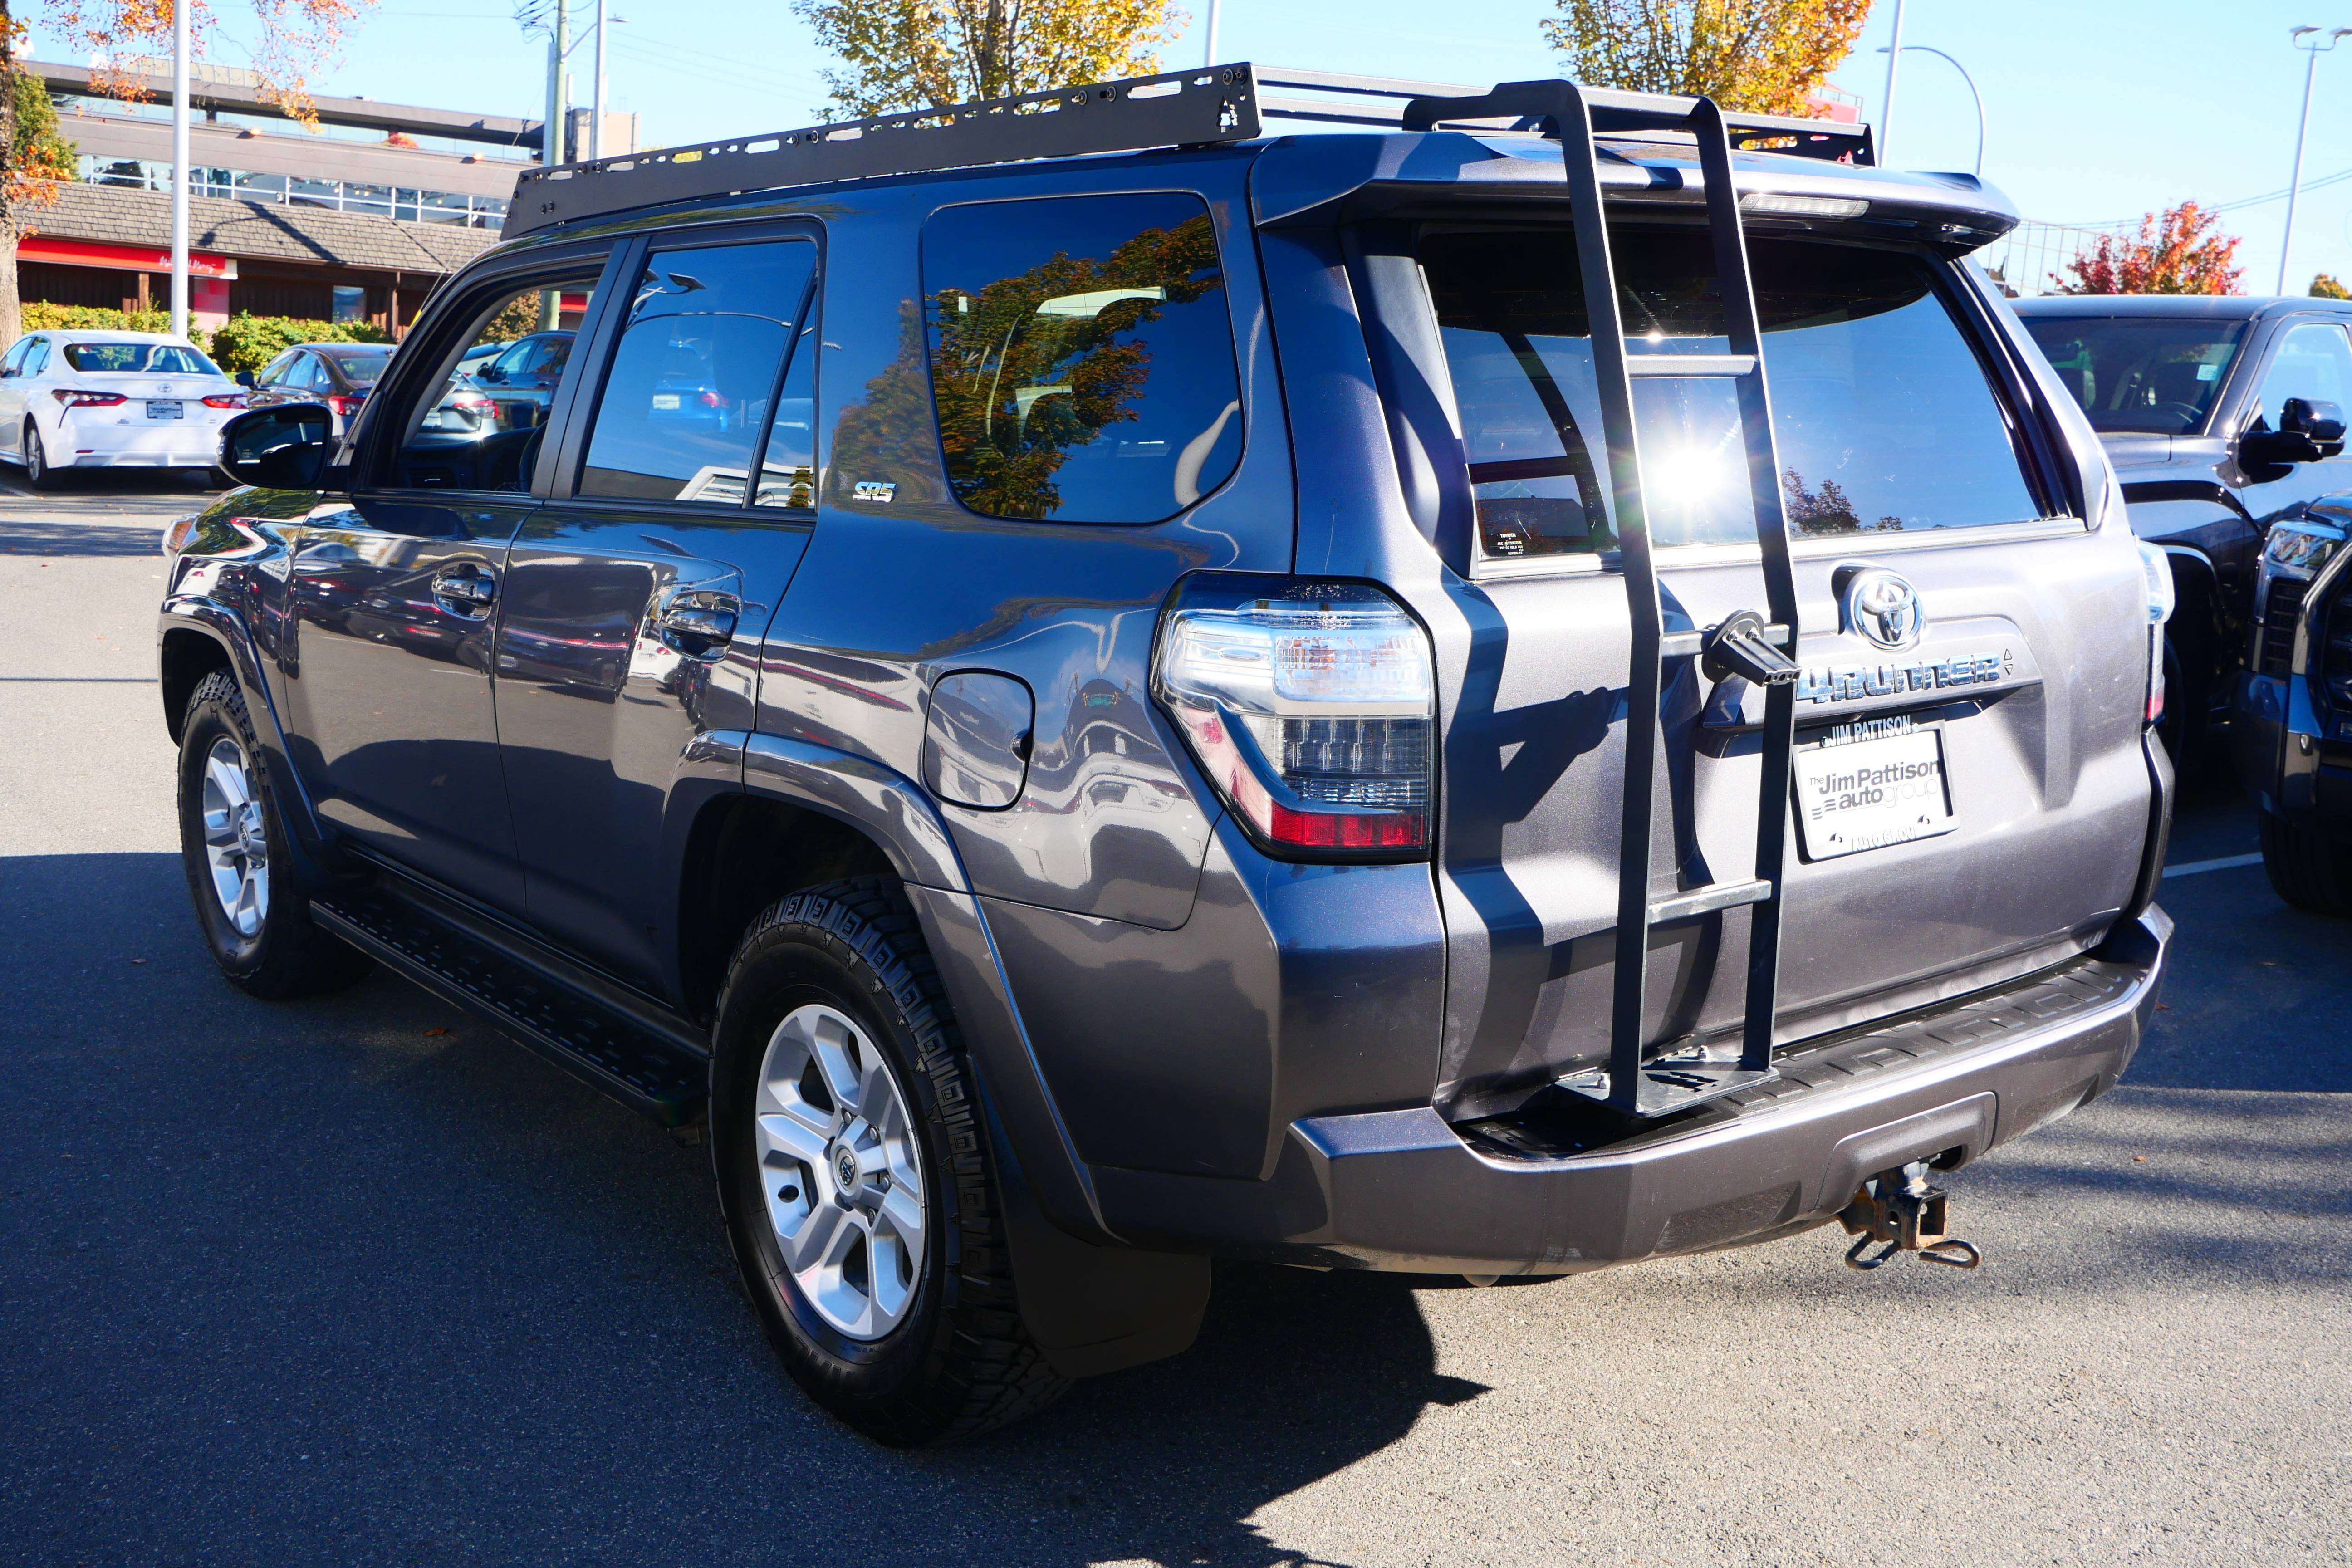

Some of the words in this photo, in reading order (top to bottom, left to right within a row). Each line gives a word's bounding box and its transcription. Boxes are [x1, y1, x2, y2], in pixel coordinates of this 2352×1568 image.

[853, 481, 897, 502] SR5
[1829, 724, 1851, 747] JIM
[1854, 715, 1911, 742] PATTISON
[1809, 776, 1824, 786] The
[1819, 773, 1855, 795] Jim
[1857, 760, 1940, 788] Pattison
